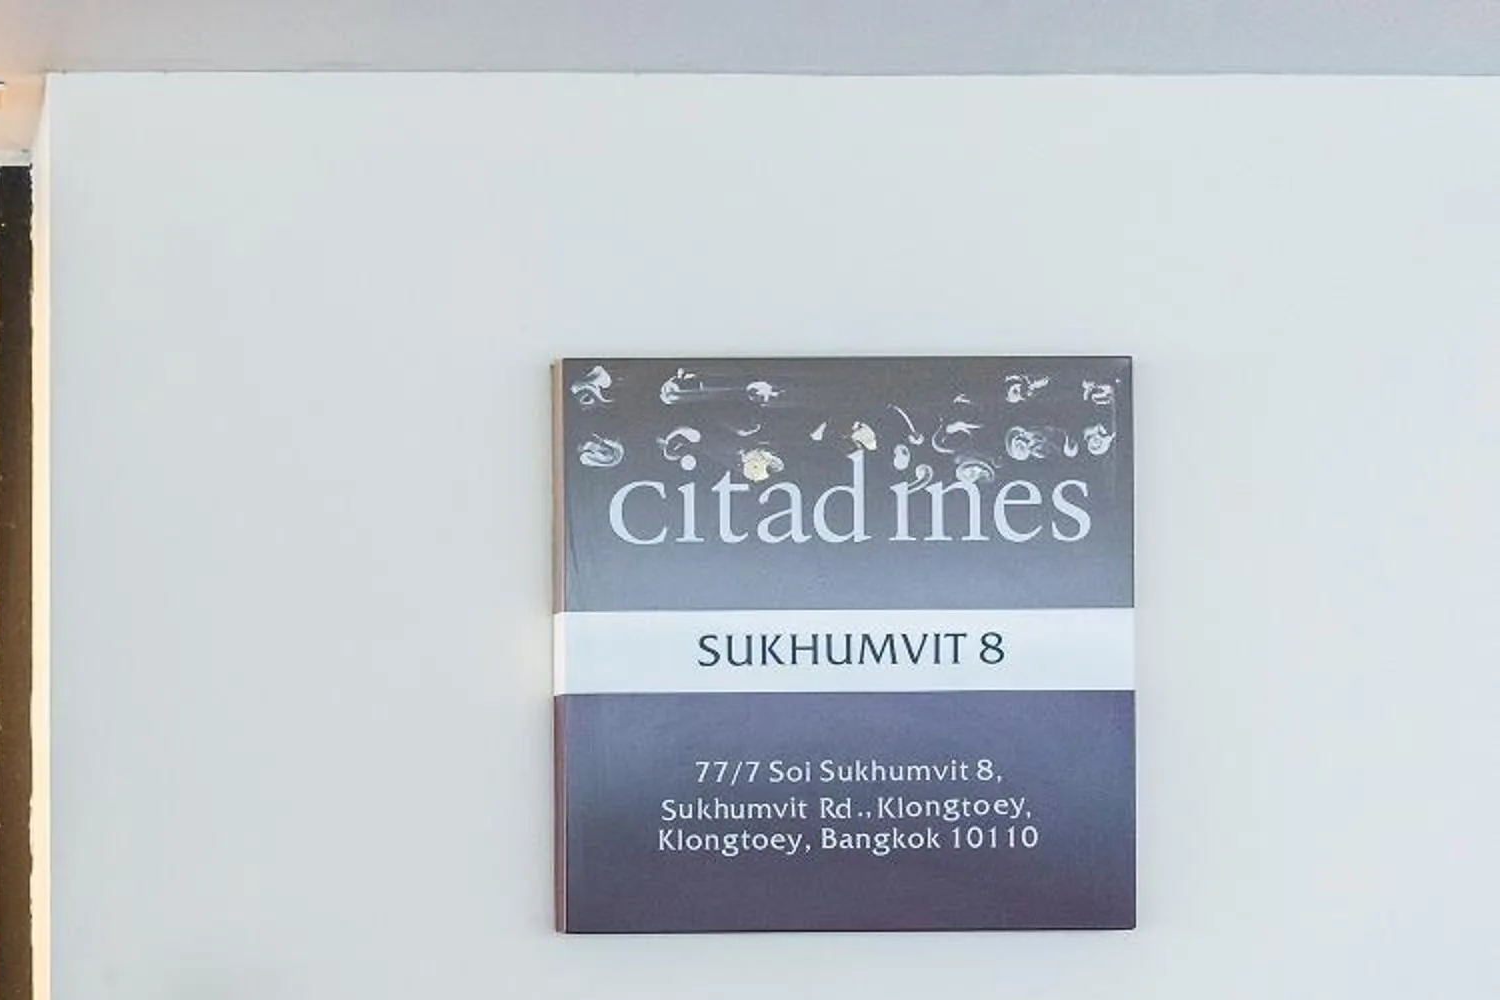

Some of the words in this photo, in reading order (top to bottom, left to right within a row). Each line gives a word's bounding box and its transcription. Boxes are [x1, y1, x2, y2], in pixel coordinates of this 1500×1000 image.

[610, 450, 1091, 545] citadines
[697, 632, 968, 667] SUKHUMVIT
[979, 631, 1005, 665] 8
[695, 760, 761, 786] 77/7
[769, 759, 811, 783] Soi
[819, 759, 969, 783] Sukhumvit
[976, 758, 1003, 784] 8,
[661, 797, 808, 821] Sukhumvit
[877, 796, 1031, 821] Klongtoey,
[658, 828, 811, 857] Klongtoey,
[821, 826, 941, 857] Bangkok
[951, 825, 1039, 849] 10110
